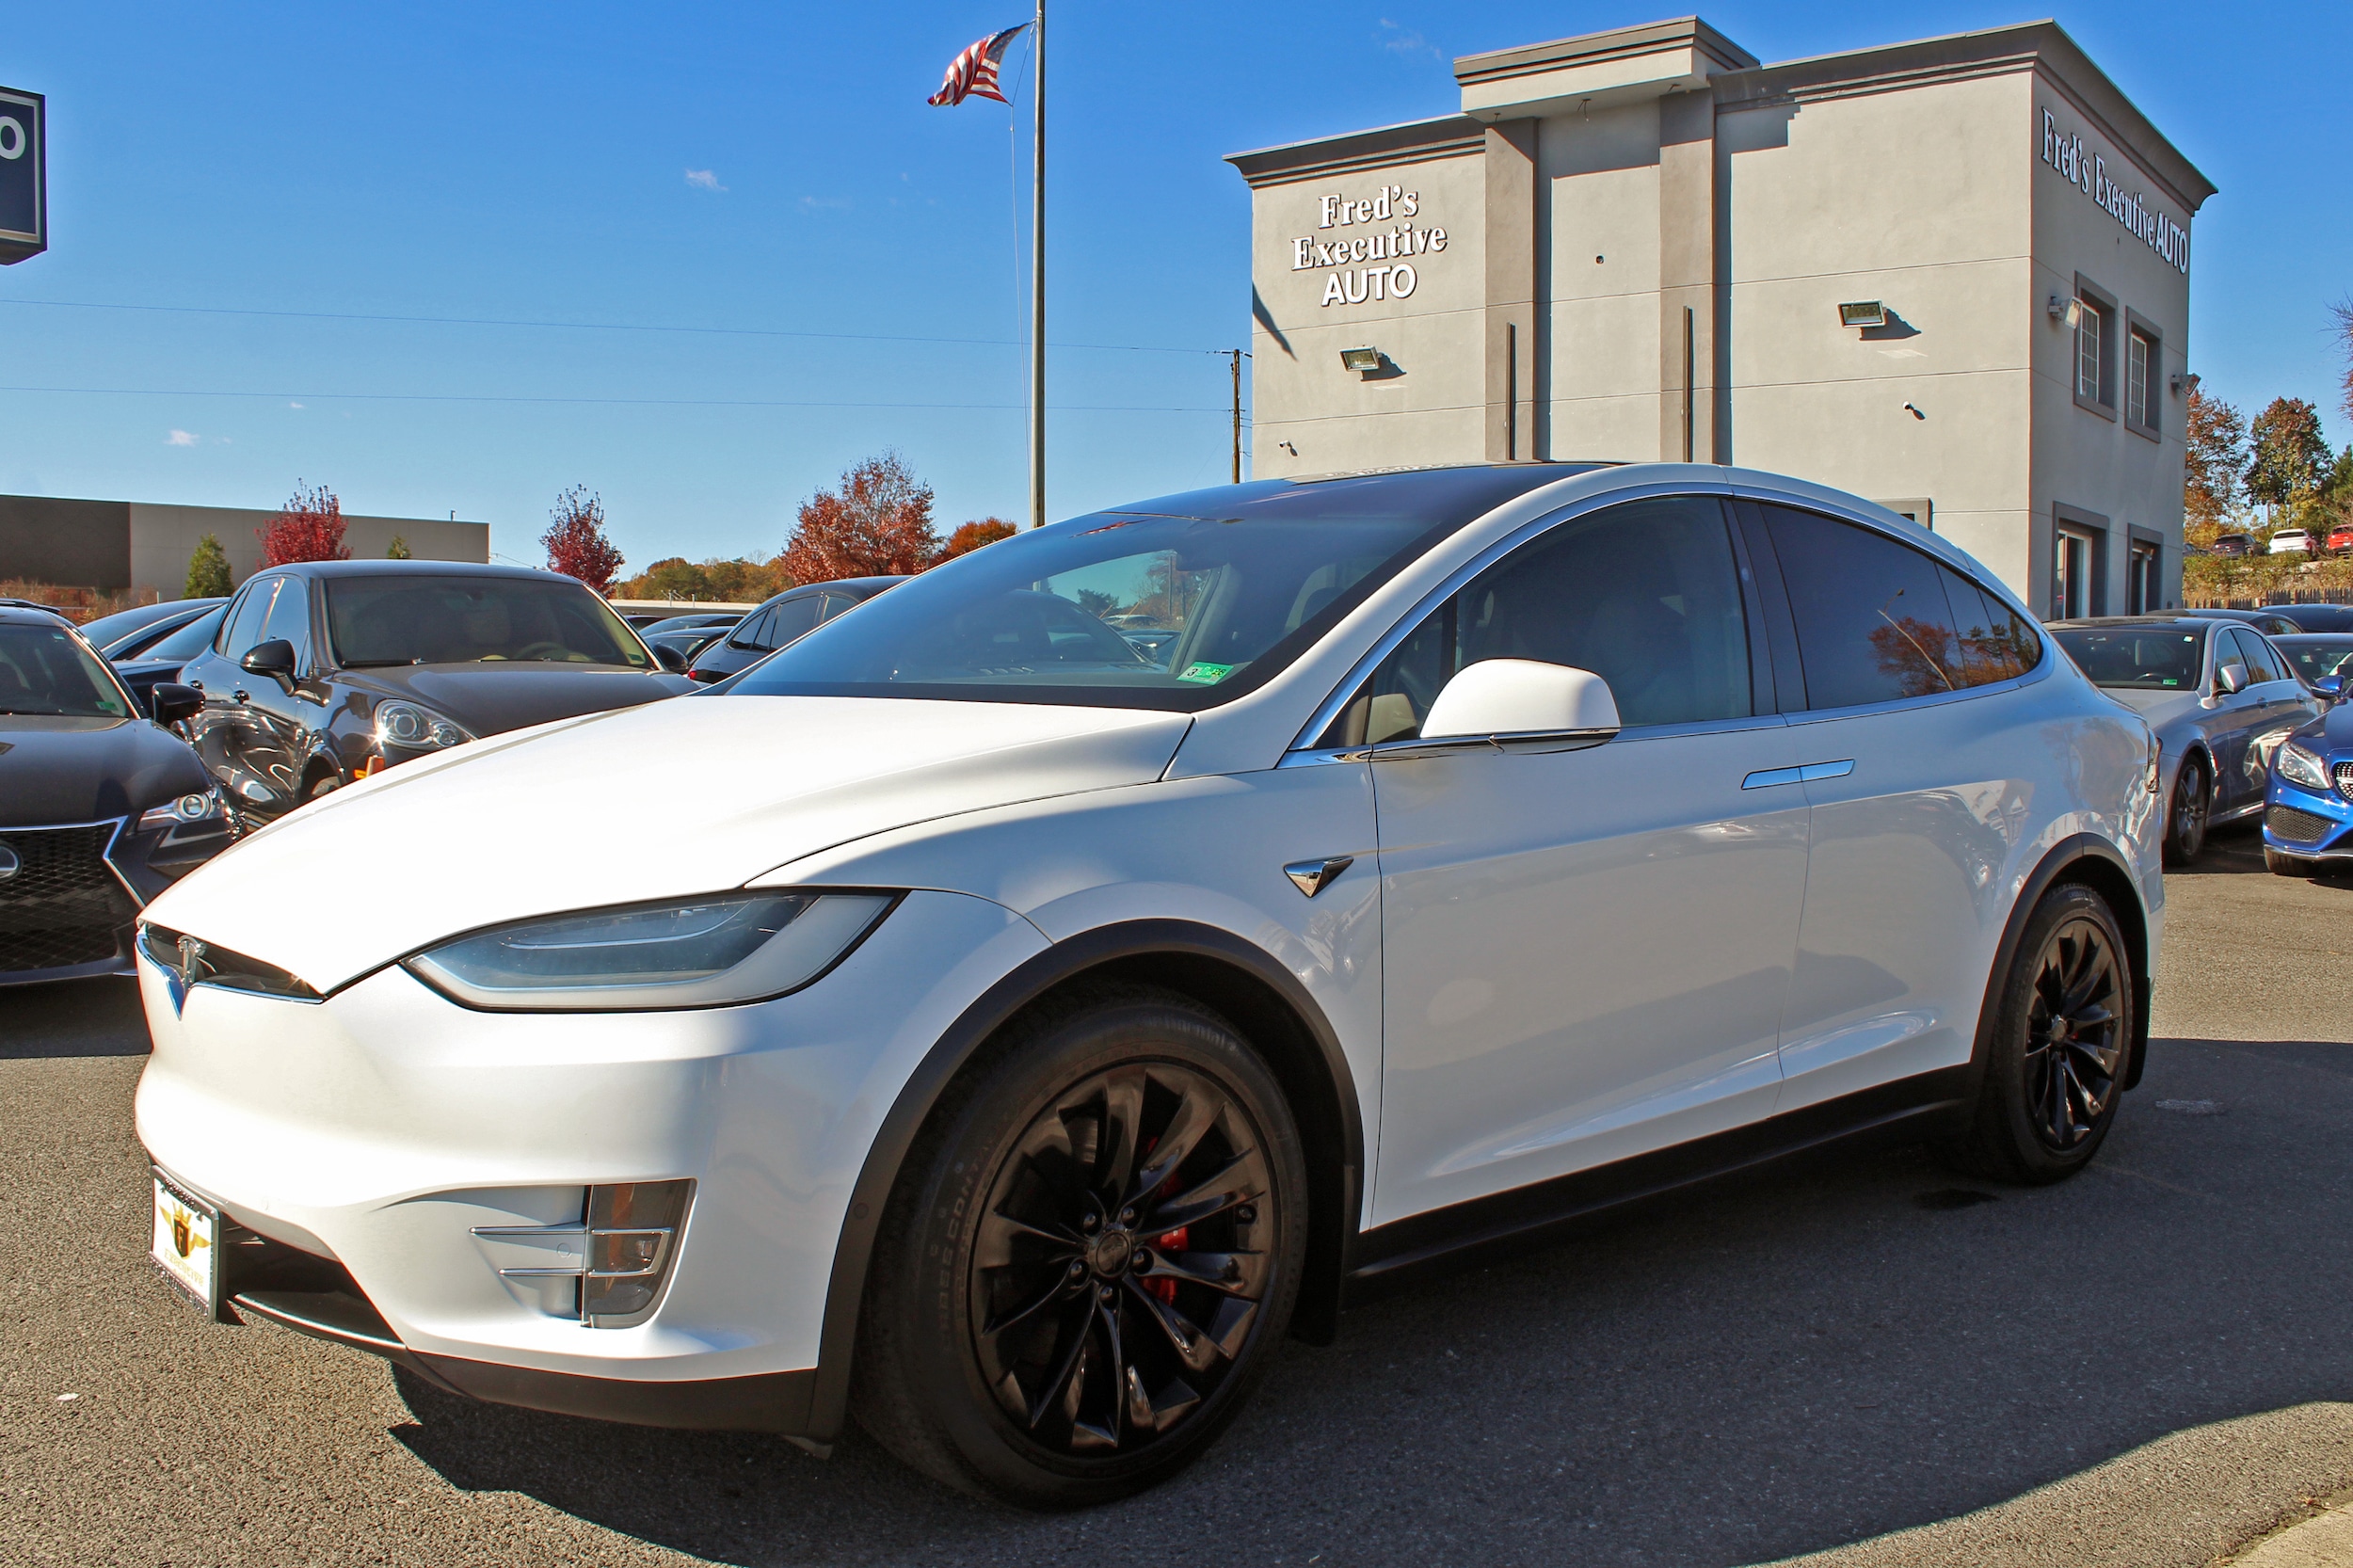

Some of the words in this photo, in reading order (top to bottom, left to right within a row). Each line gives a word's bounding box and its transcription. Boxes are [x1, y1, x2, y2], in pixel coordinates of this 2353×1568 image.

[2093, 153, 2154, 247] Executive
[2154, 211, 2188, 274] AUTO
[1291, 222, 1448, 270] Executive
[1321, 263, 1417, 307] AUTO
